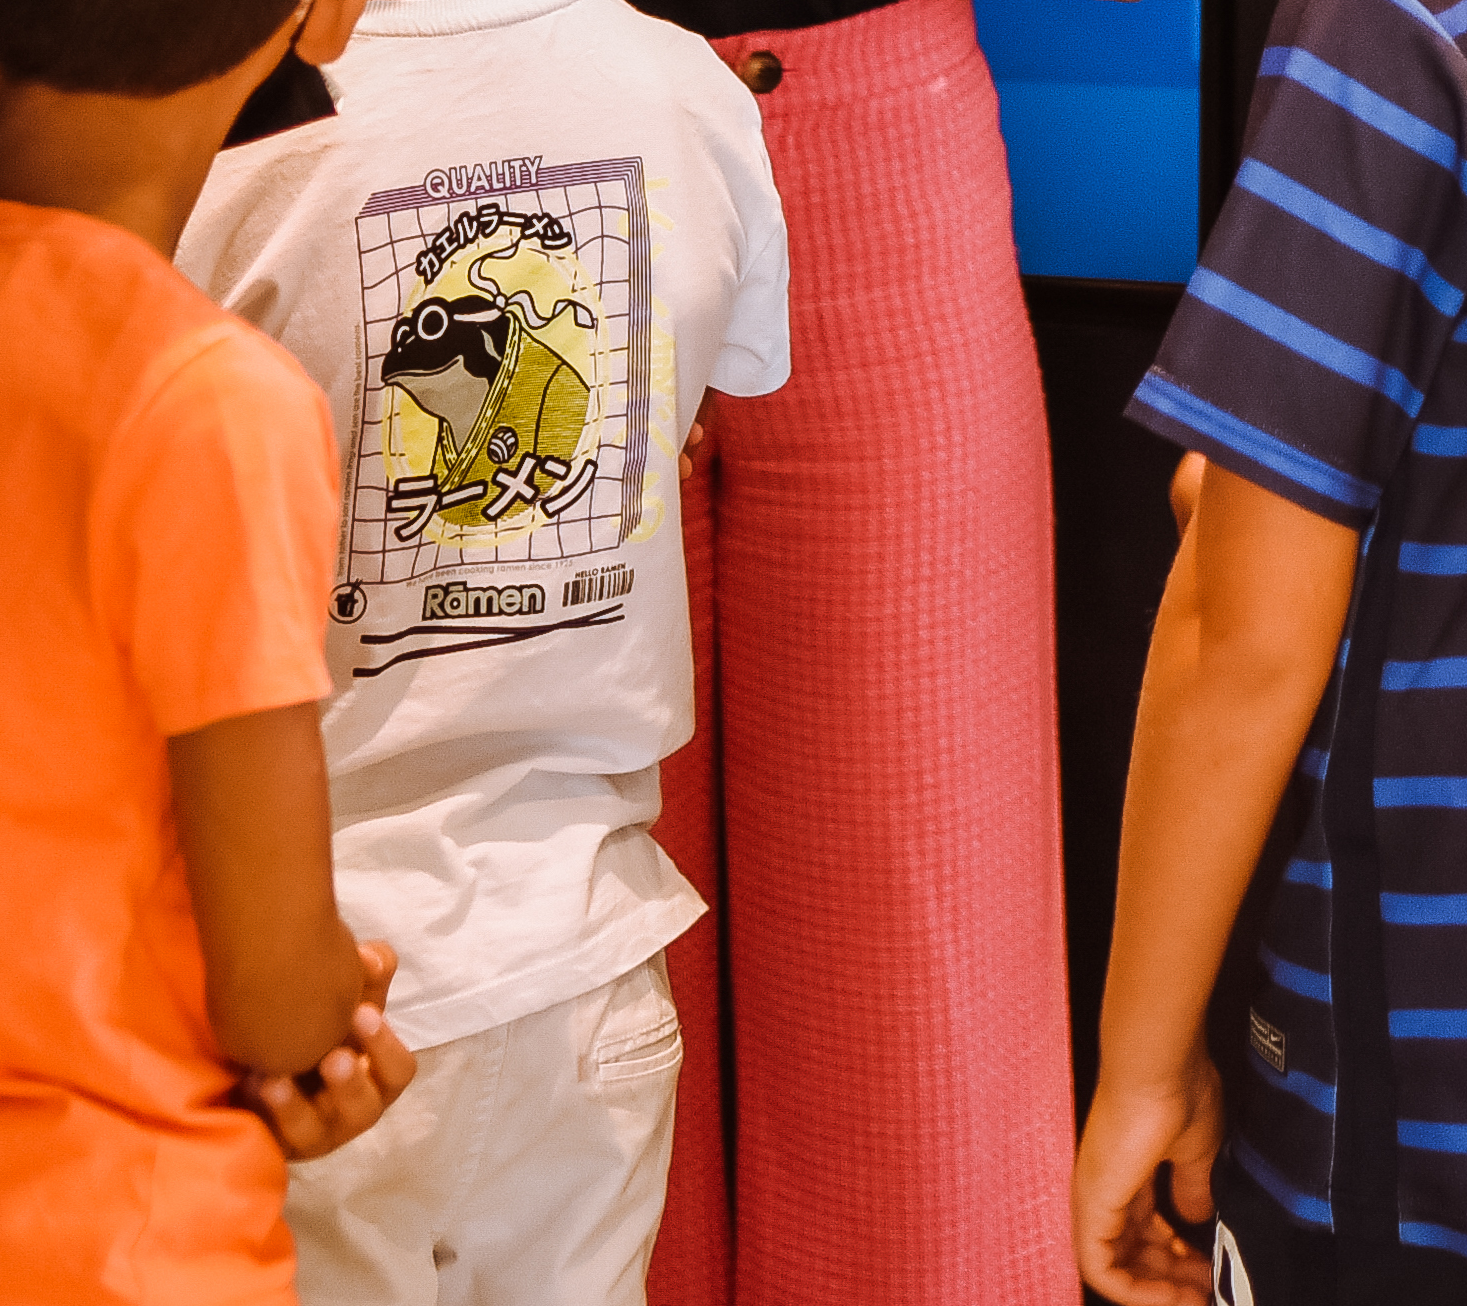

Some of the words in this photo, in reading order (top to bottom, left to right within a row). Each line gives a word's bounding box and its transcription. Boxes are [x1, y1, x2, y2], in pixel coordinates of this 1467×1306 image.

[424, 155, 543, 199] QUALITY
[386, 452, 598, 543] ラーメン
[574, 568, 599, 579] HELLO
[421, 580, 546, 621] Rāmen
